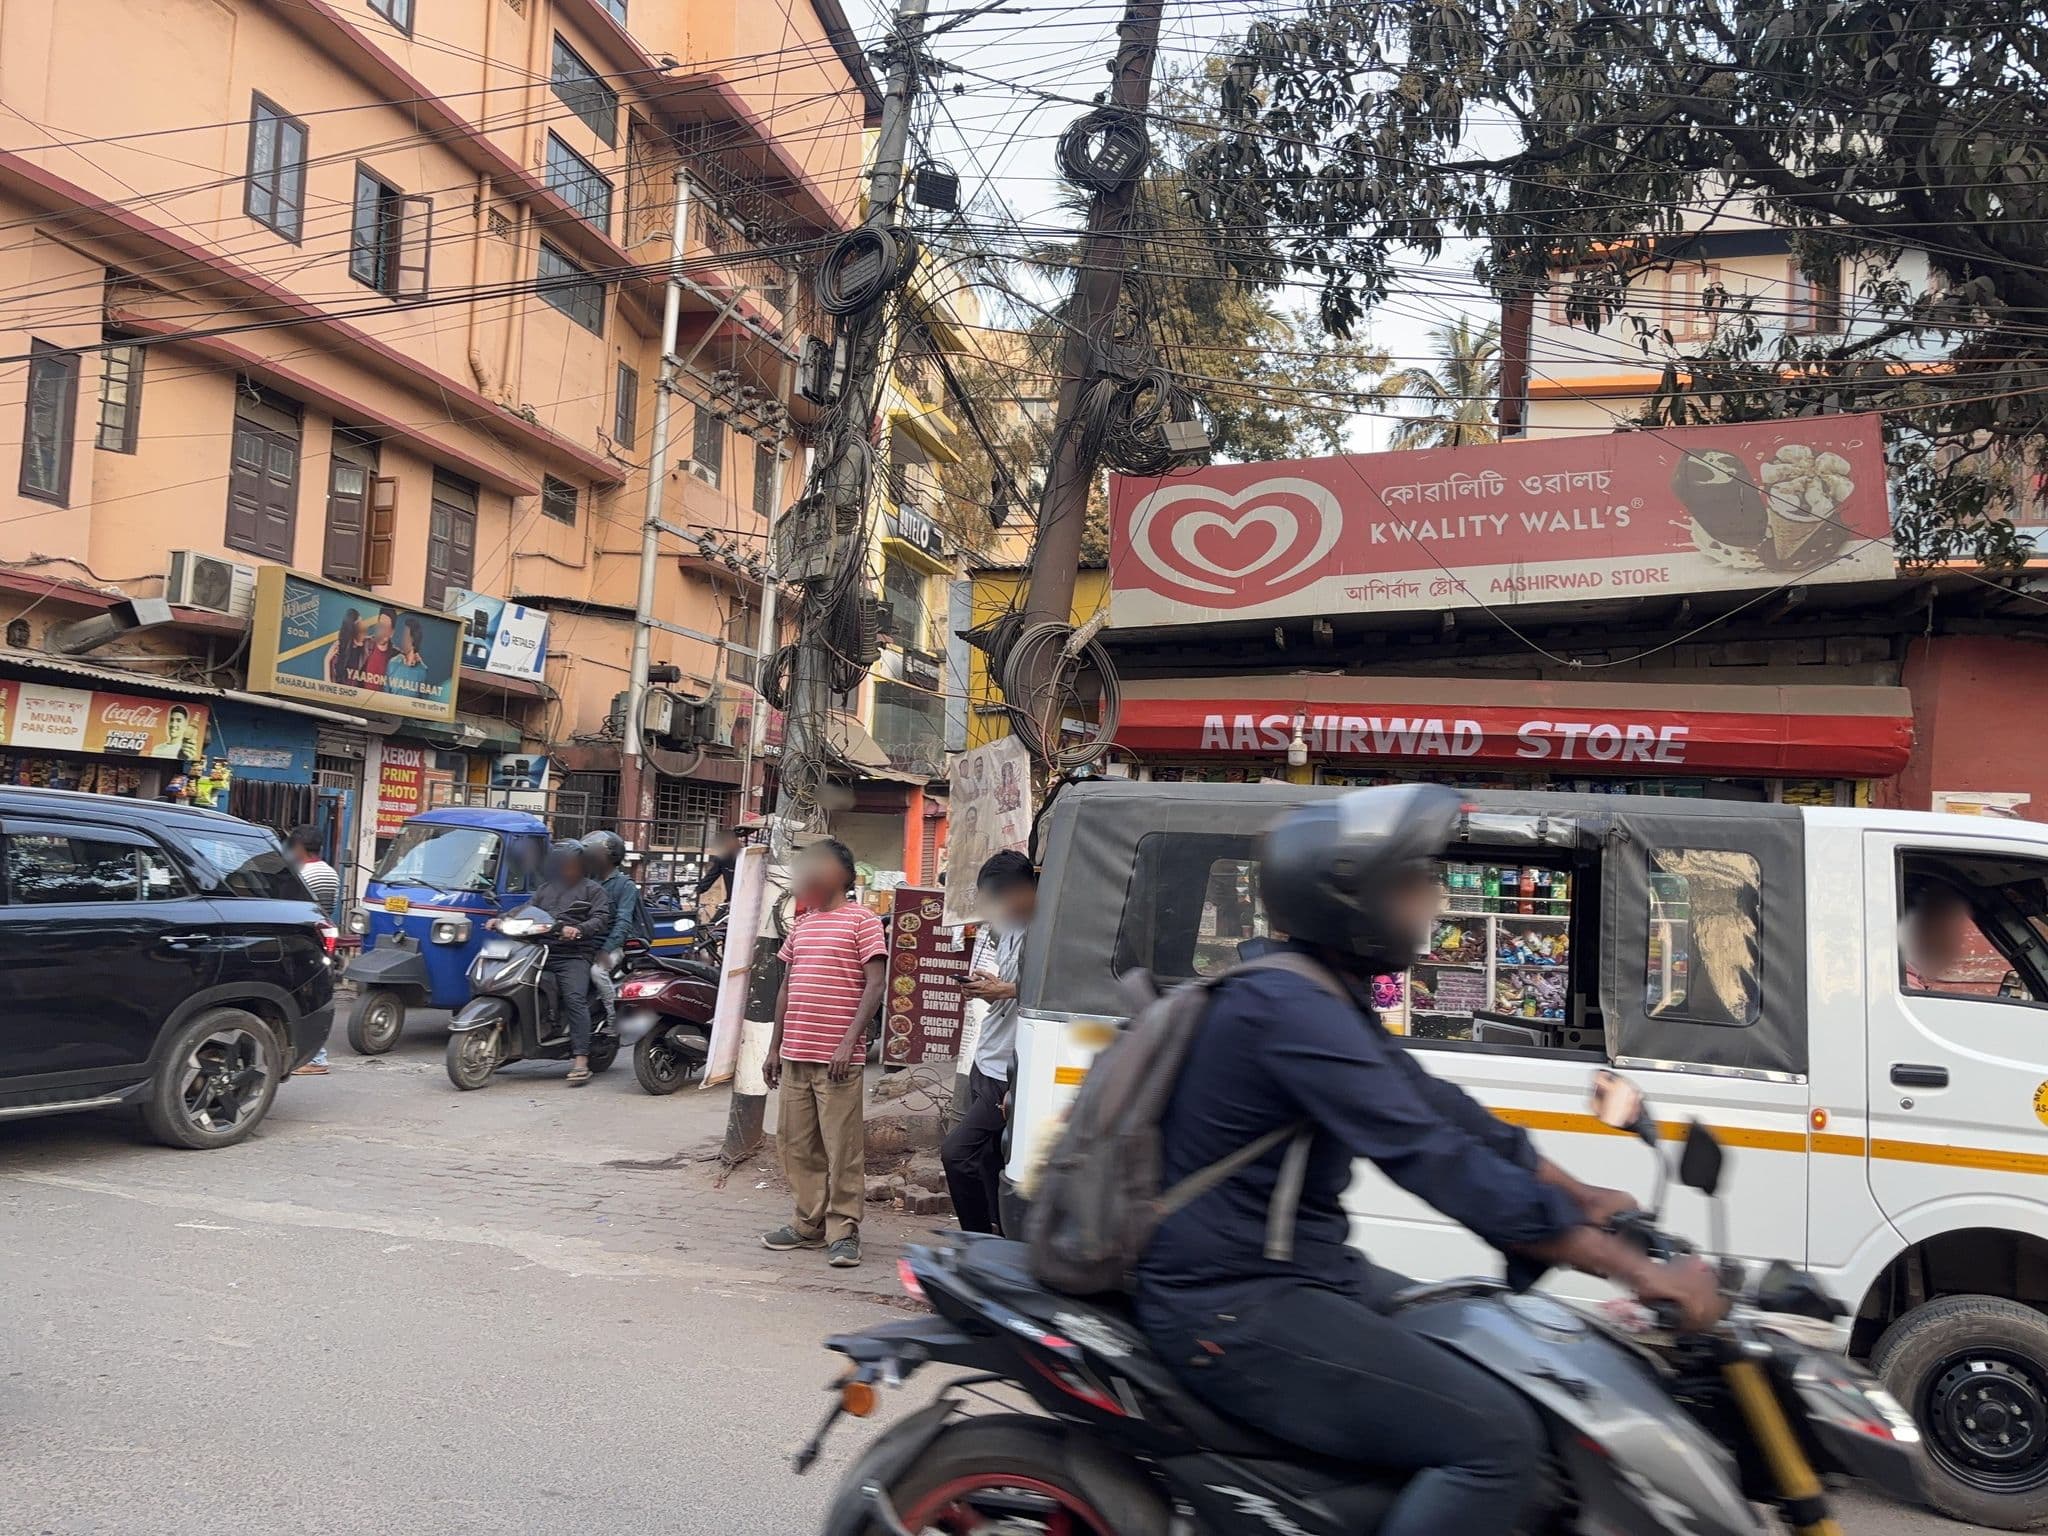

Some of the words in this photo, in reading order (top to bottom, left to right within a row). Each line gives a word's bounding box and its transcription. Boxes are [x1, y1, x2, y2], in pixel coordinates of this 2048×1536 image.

[1371, 512, 1509, 544] KWALITY
[1520, 505, 1632, 534] WALL'S
[1489, 572, 1603, 593] AASHIRWAD
[1612, 567, 1670, 586] STORE
[287, 627, 310, 639] SODA
[346, 667, 387, 685] YAARON
[389, 676, 418, 693] WAALI
[420, 682, 443, 697] BAAT
[318, 684, 339, 695] WINE
[339, 687, 358, 697] SHOP
[31, 712, 72, 724] MUNNA
[20, 722, 43, 733] PAN
[46, 724, 79, 736] SHOP
[108, 729, 131, 739] KHUD
[131, 731, 149, 740] KO
[104, 737, 145, 751] JAGAO
[1200, 713, 1484, 757] AASHIRWAD
[1516, 720, 1690, 764] STORE
[381, 746, 420, 767] XEROX
[383, 767, 417, 783] PRINT
[379, 784, 418, 800] PHOTO
[935, 942, 953, 953] ROL
[920, 957, 969, 970] CHOWMEIN
[920, 973, 944, 985] FRIED
[922, 990, 960, 1003] CHICKEN
[923, 1000, 958, 1012] BIRYANI
[920, 1016, 959, 1029] CHICKEN
[923, 1026, 955, 1038] CURRY
[925, 1043, 950, 1054] PORK
